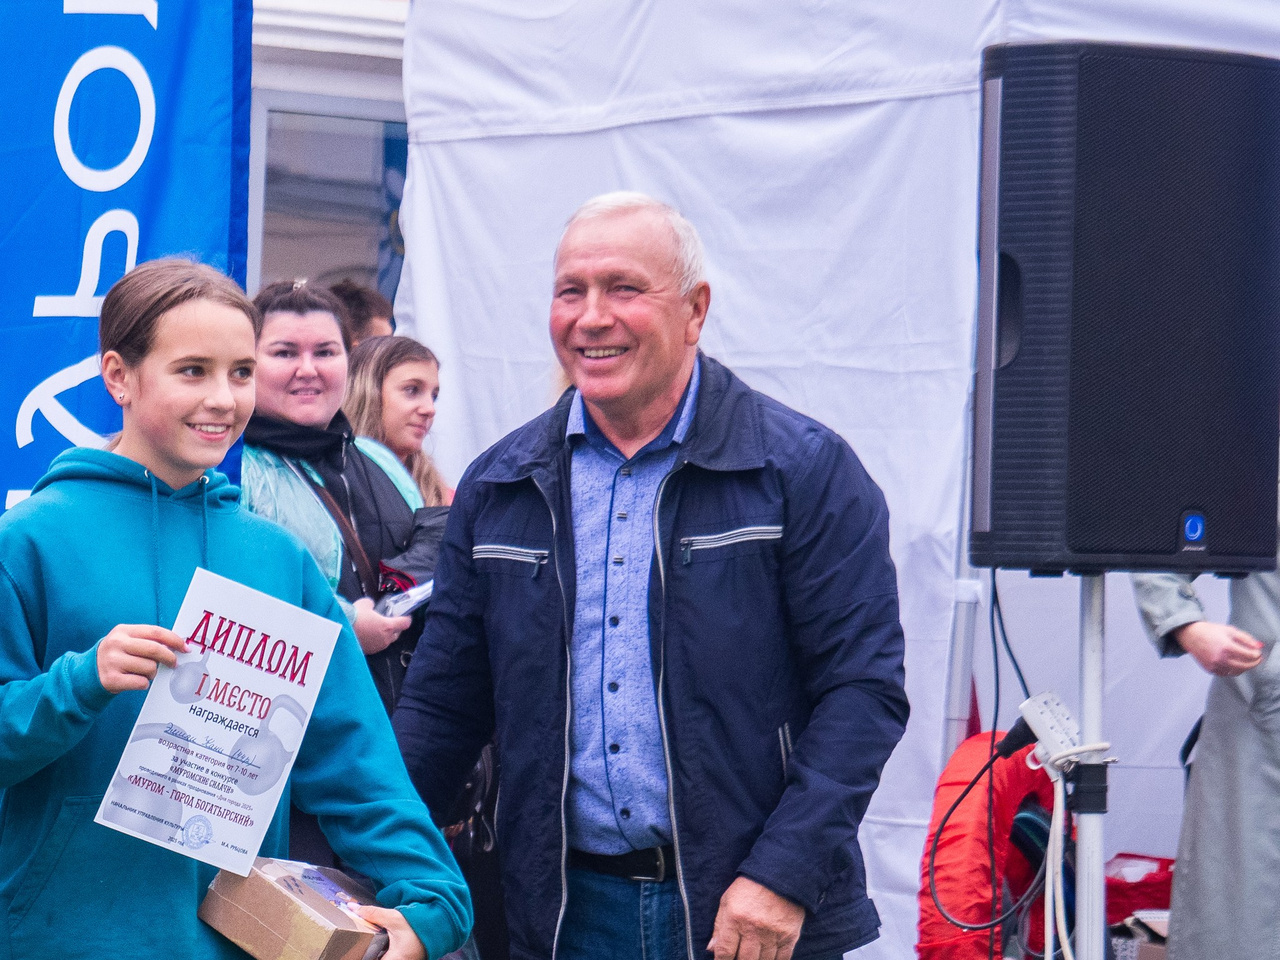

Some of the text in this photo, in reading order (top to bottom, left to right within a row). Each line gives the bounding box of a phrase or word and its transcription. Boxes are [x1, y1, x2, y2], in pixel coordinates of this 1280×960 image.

[186, 610, 313, 687] ДИПЛОМ
[208, 678, 271, 720] МЕСТО
[189, 704, 260, 738] награждается
[157, 737, 258, 780] возрастная категория от 7-10 лет
[178, 758, 204, 774] участие
[209, 769, 238, 786] конкурсе
[110, 799, 137, 813] НАЧАЛЬНИК
[126, 772, 165, 795] «МУРОМ
[168, 789, 195, 807] ГОРОД
[194, 796, 255, 829] БОГАТЫРСКИЙ»
